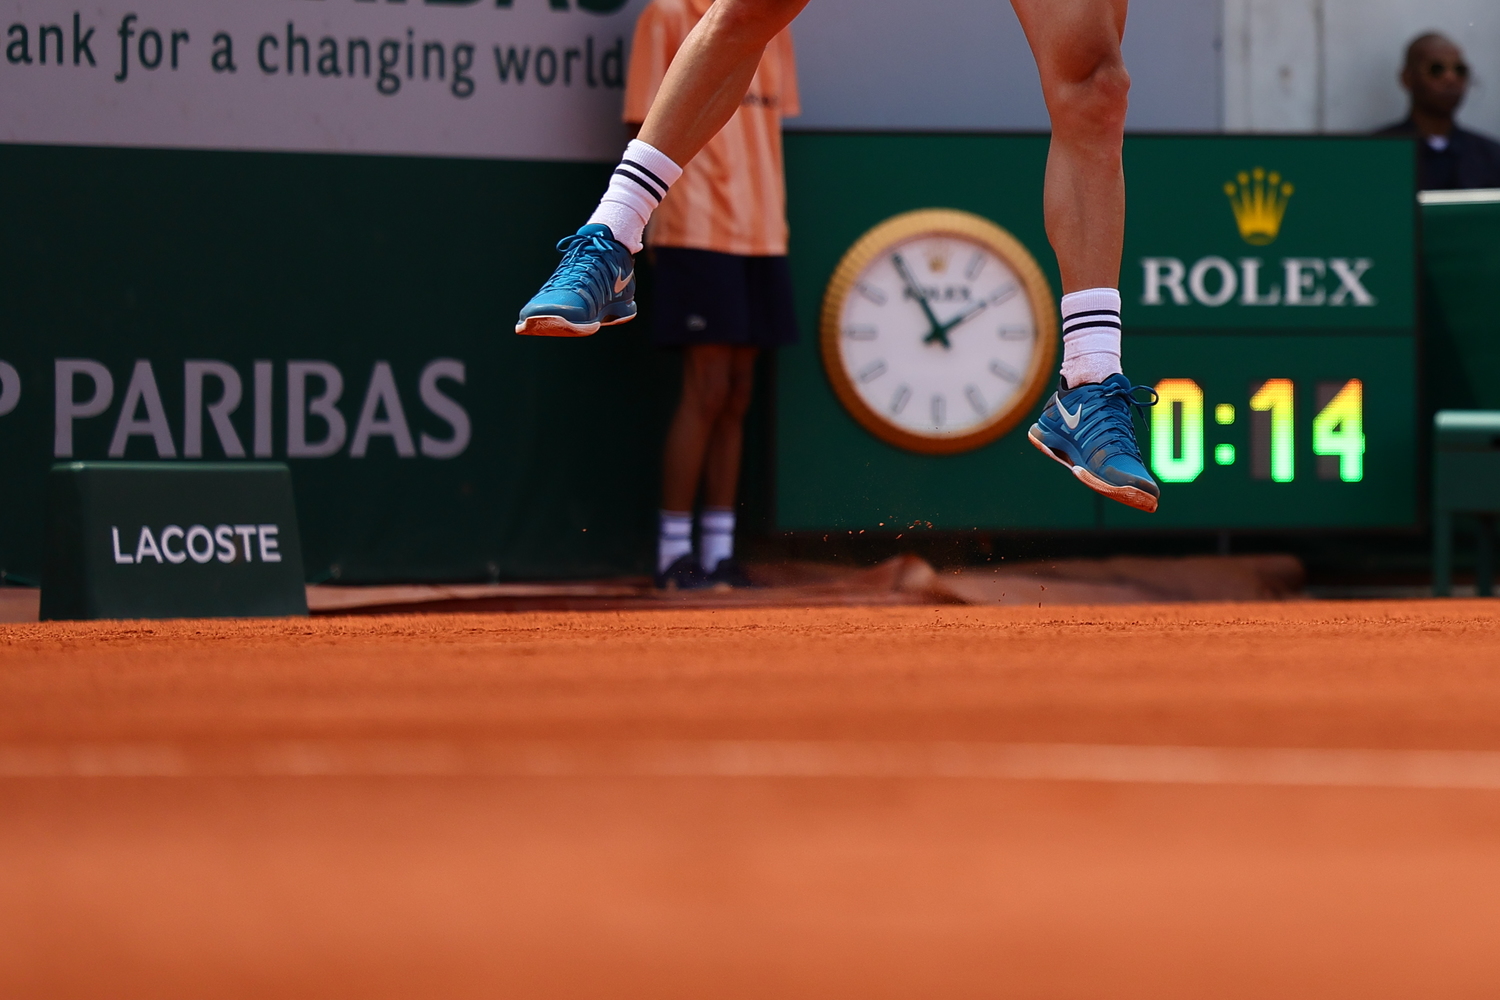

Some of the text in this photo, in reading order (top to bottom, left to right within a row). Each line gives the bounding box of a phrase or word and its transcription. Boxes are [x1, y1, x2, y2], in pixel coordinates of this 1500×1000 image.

[114, 12, 190, 83] for
[211, 32, 237, 74] a
[257, 21, 475, 98] changing
[493, 34, 626, 90] world
[1142, 257, 1376, 307] ROLEX
[54, 358, 472, 459] PARIBAS
[1150, 377, 1366, 483] 0:14
[111, 524, 282, 565] LACOSTE
